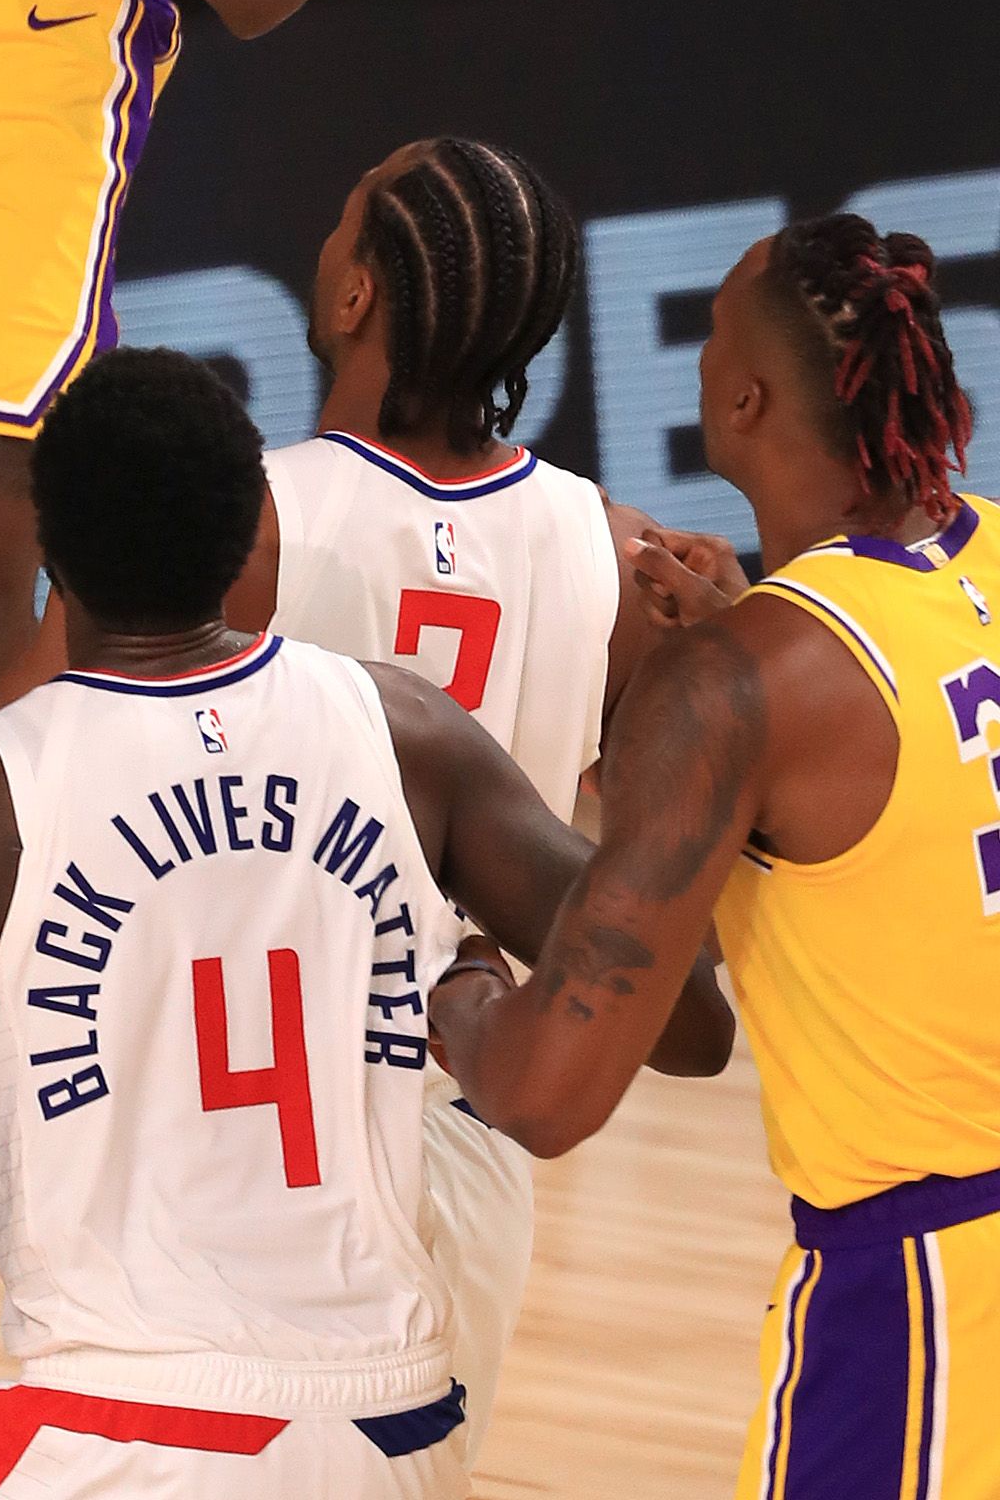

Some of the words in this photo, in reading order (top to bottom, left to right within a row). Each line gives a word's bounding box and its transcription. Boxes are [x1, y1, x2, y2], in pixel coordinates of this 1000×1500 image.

[28, 861, 135, 1121] BLACK
[111, 774, 298, 881] LIVES
[312, 798, 428, 1071] MATTER
[191, 948, 321, 1188] 4
